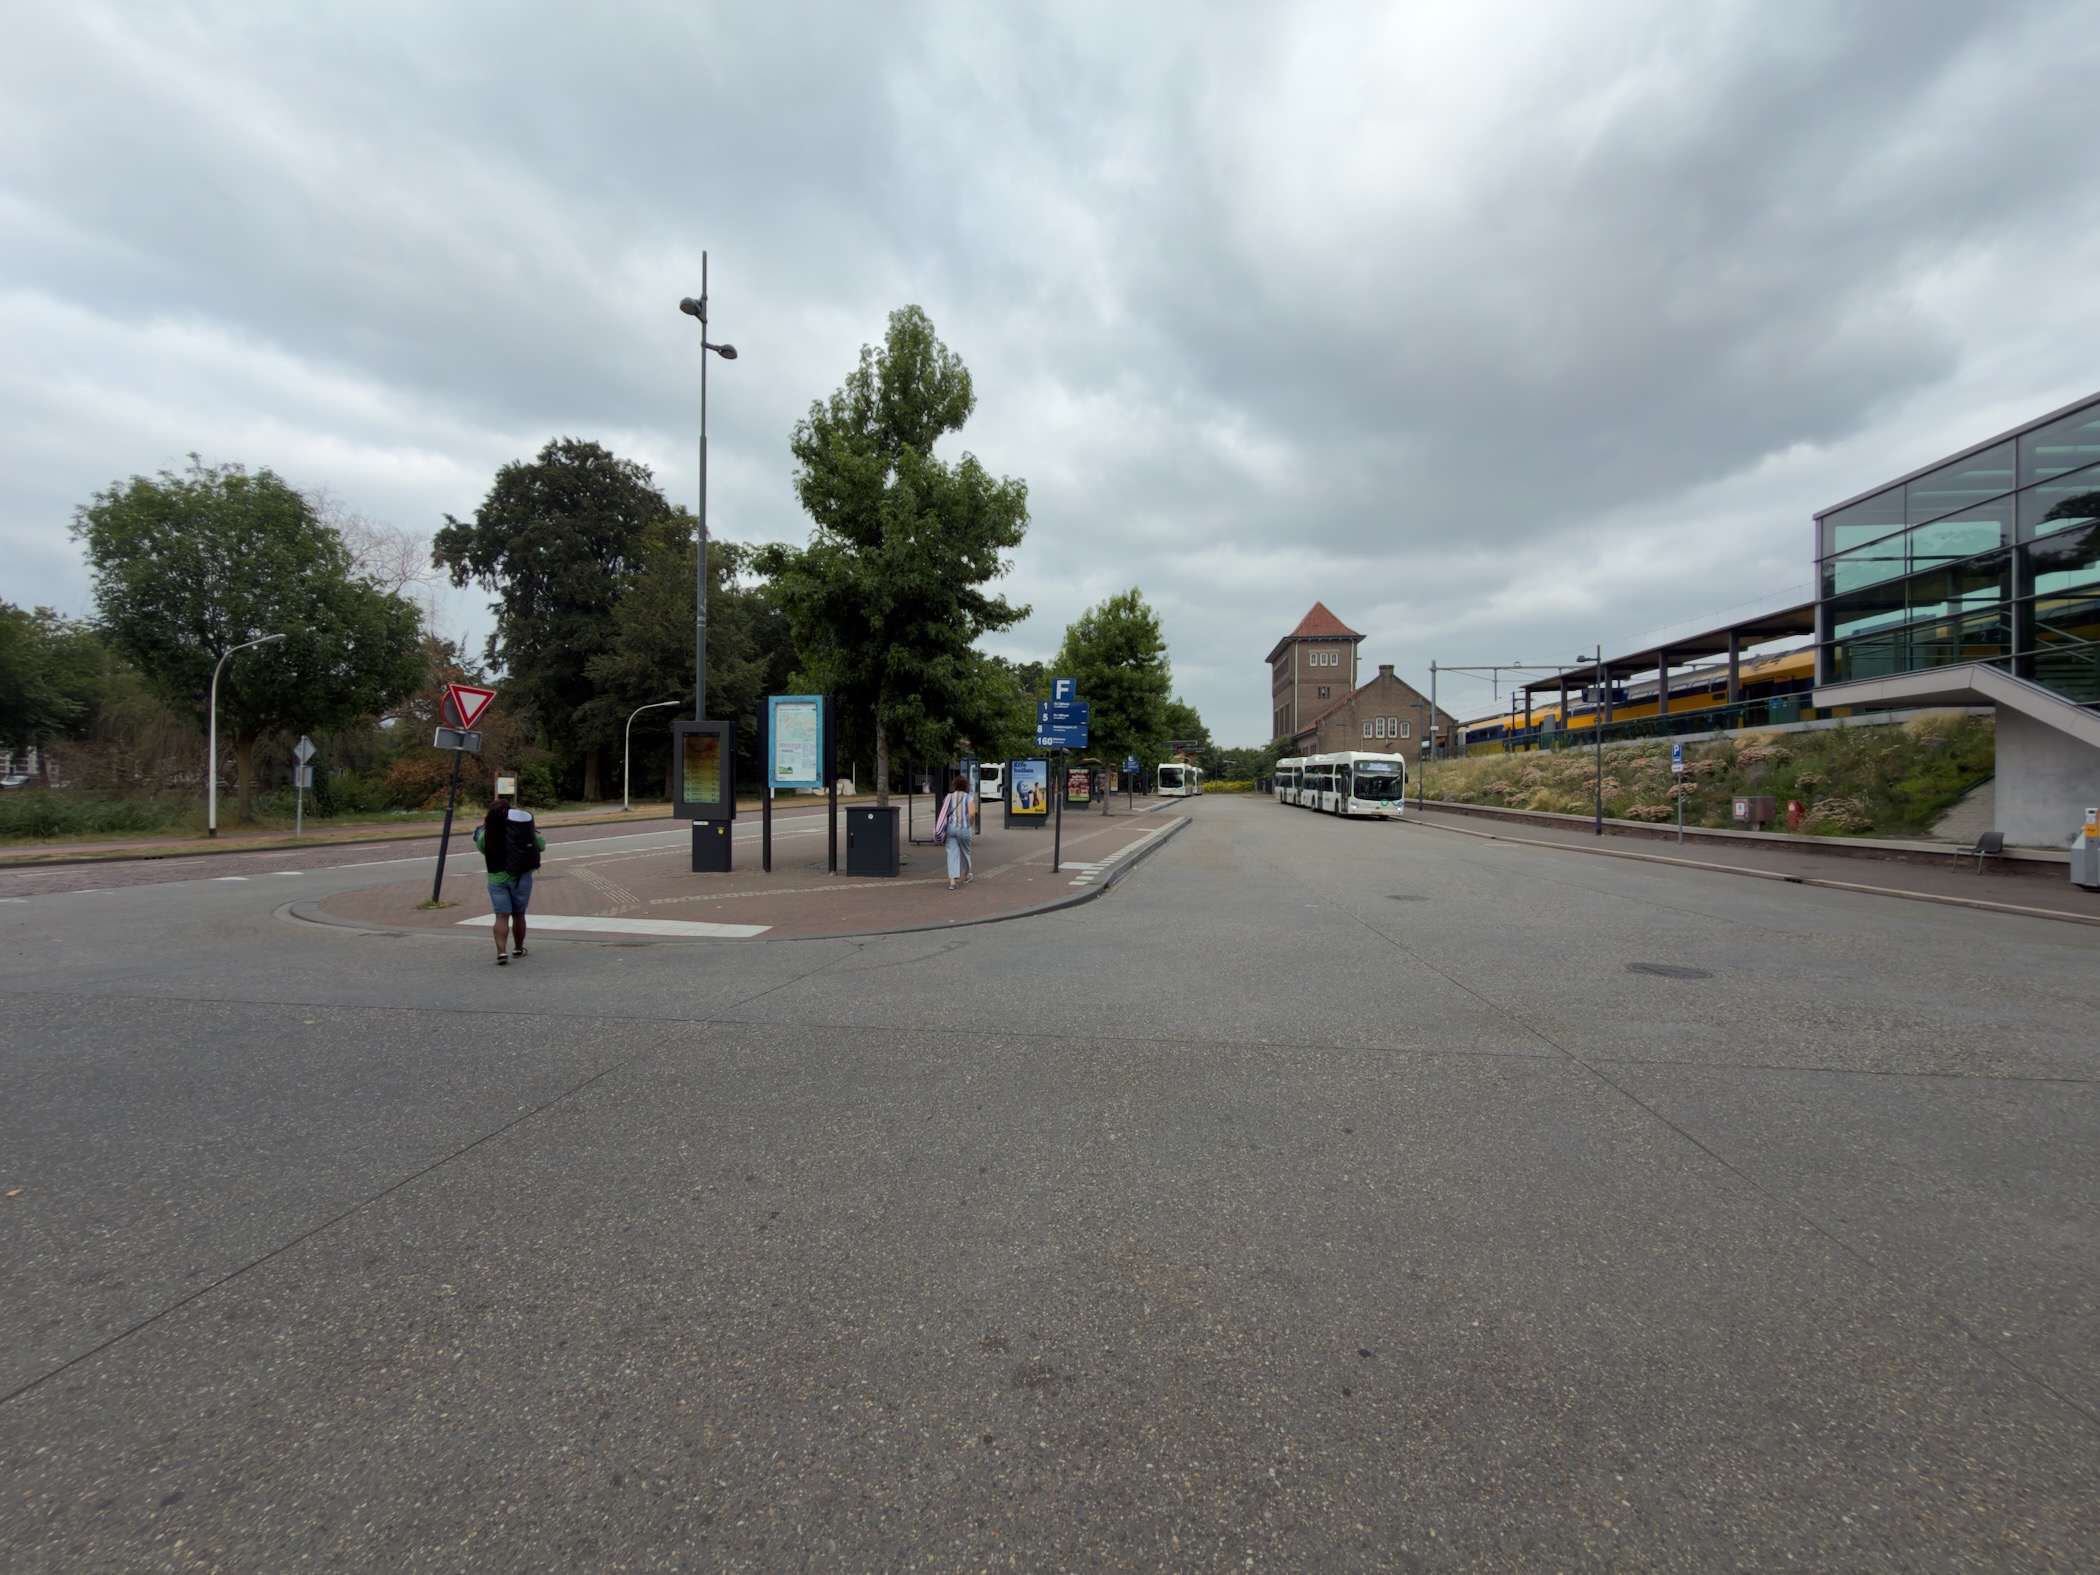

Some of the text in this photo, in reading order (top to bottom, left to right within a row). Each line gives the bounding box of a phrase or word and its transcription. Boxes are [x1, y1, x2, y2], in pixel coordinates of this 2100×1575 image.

[1056, 680, 1070, 700] F
[1043, 702, 1048, 710] 1
[1042, 713, 1048, 721] 5
[1037, 725, 1042, 733] 8
[1037, 737, 1052, 745] 160
[1674, 744, 1679, 755] P
